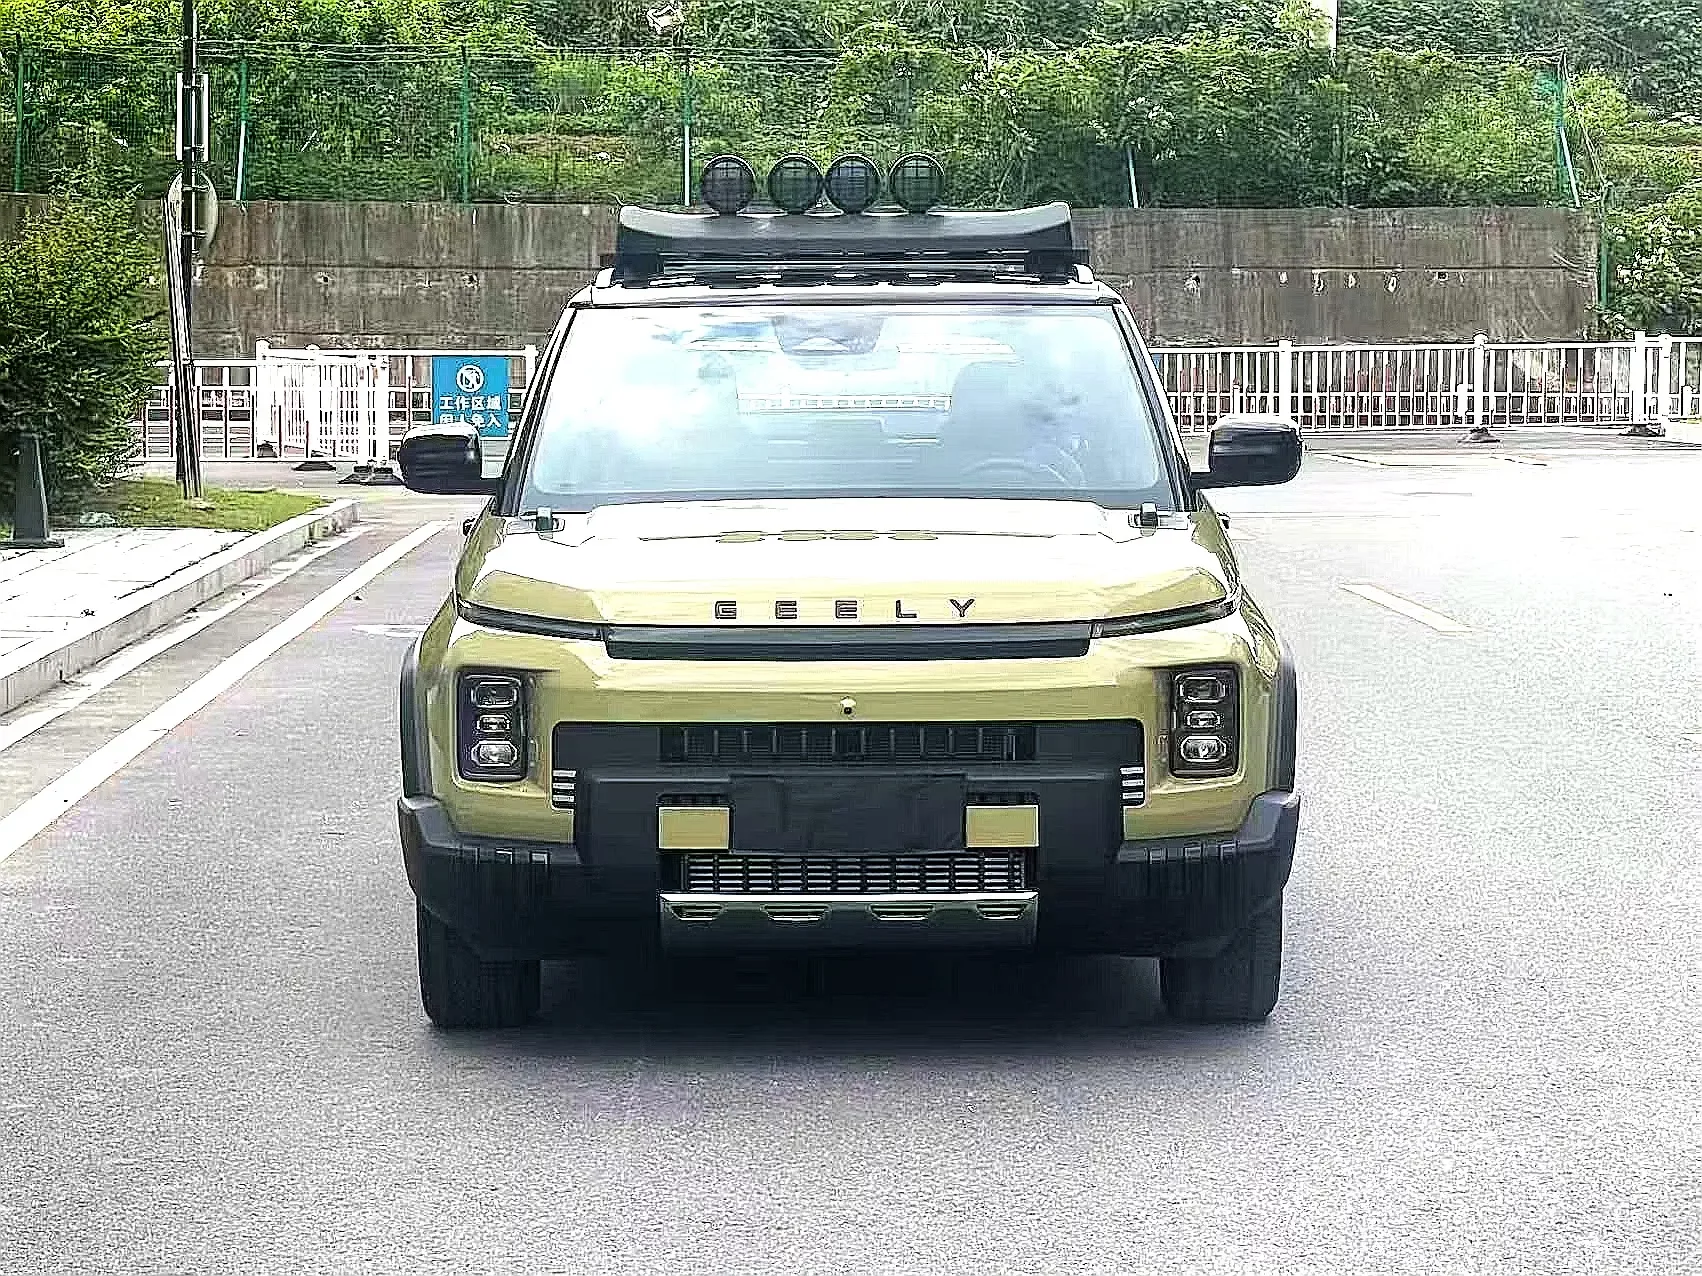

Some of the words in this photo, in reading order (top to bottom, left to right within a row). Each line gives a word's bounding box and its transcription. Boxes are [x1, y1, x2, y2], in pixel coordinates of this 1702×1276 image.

[439, 395, 502, 411] 工作区域
[714, 598, 976, 620] GEELY
